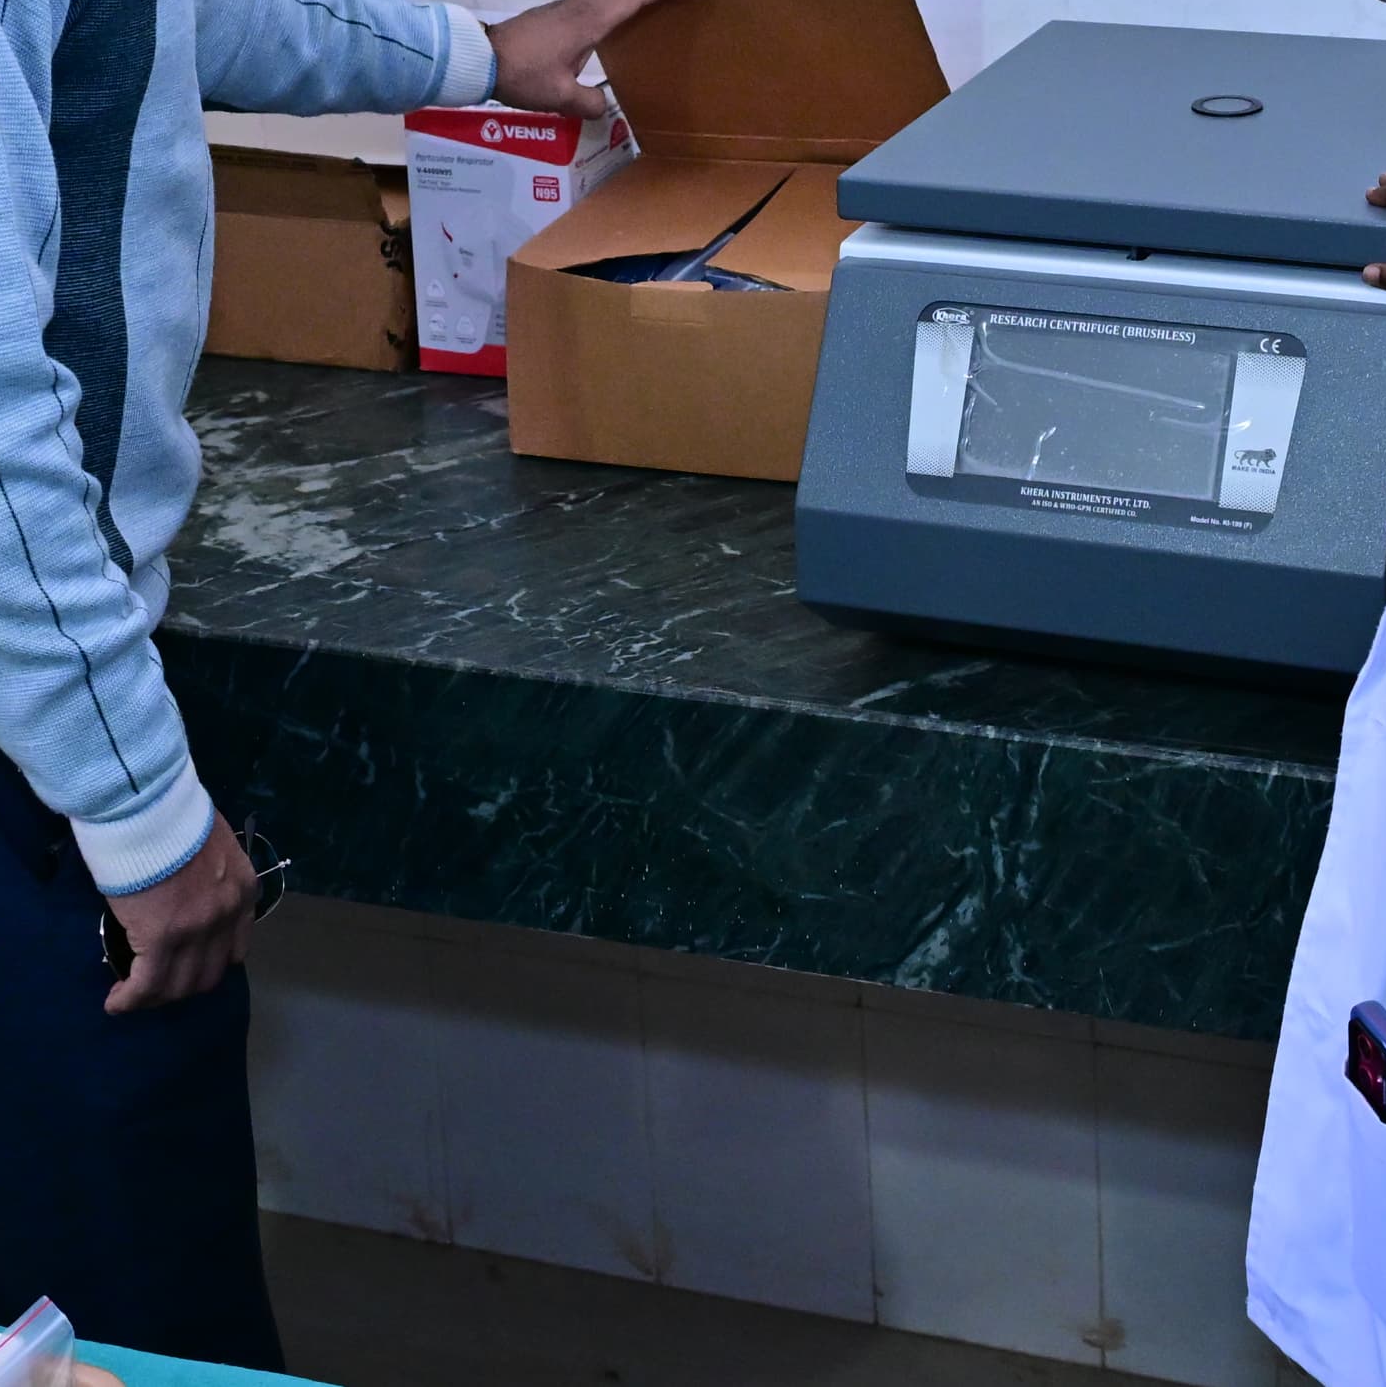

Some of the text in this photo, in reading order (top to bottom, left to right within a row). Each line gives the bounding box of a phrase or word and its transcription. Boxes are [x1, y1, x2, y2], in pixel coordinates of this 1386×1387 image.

[502, 125, 557, 141] VENUS
[535, 187, 559, 201] N95
[990, 313, 1197, 345] RESEARCH CENTRIFUGE (BRUSHLESS)
[1259, 337, 1282, 354] CE
[1020, 486, 1152, 510] KHERA INSTRUMENTS PVT. LTD.
